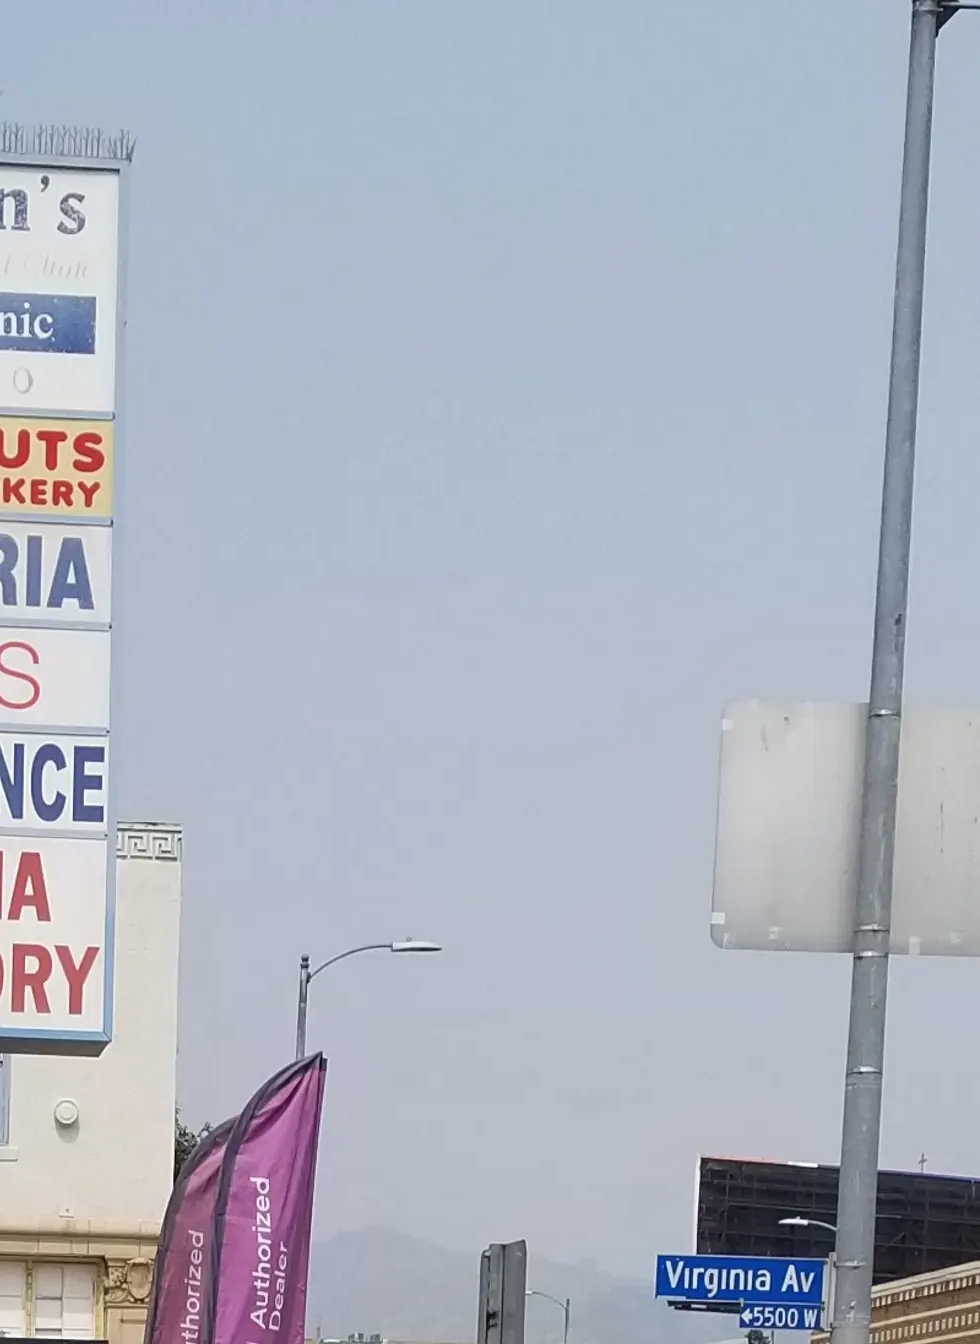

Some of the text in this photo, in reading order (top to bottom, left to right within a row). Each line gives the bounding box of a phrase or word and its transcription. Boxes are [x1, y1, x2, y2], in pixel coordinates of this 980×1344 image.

[249, 1176, 273, 1330] Authorized
[666, 1260, 815, 1297] Virginia Av
[268, 1241, 289, 1332] Dealer
[752, 1307, 819, 1327] 5500 W
